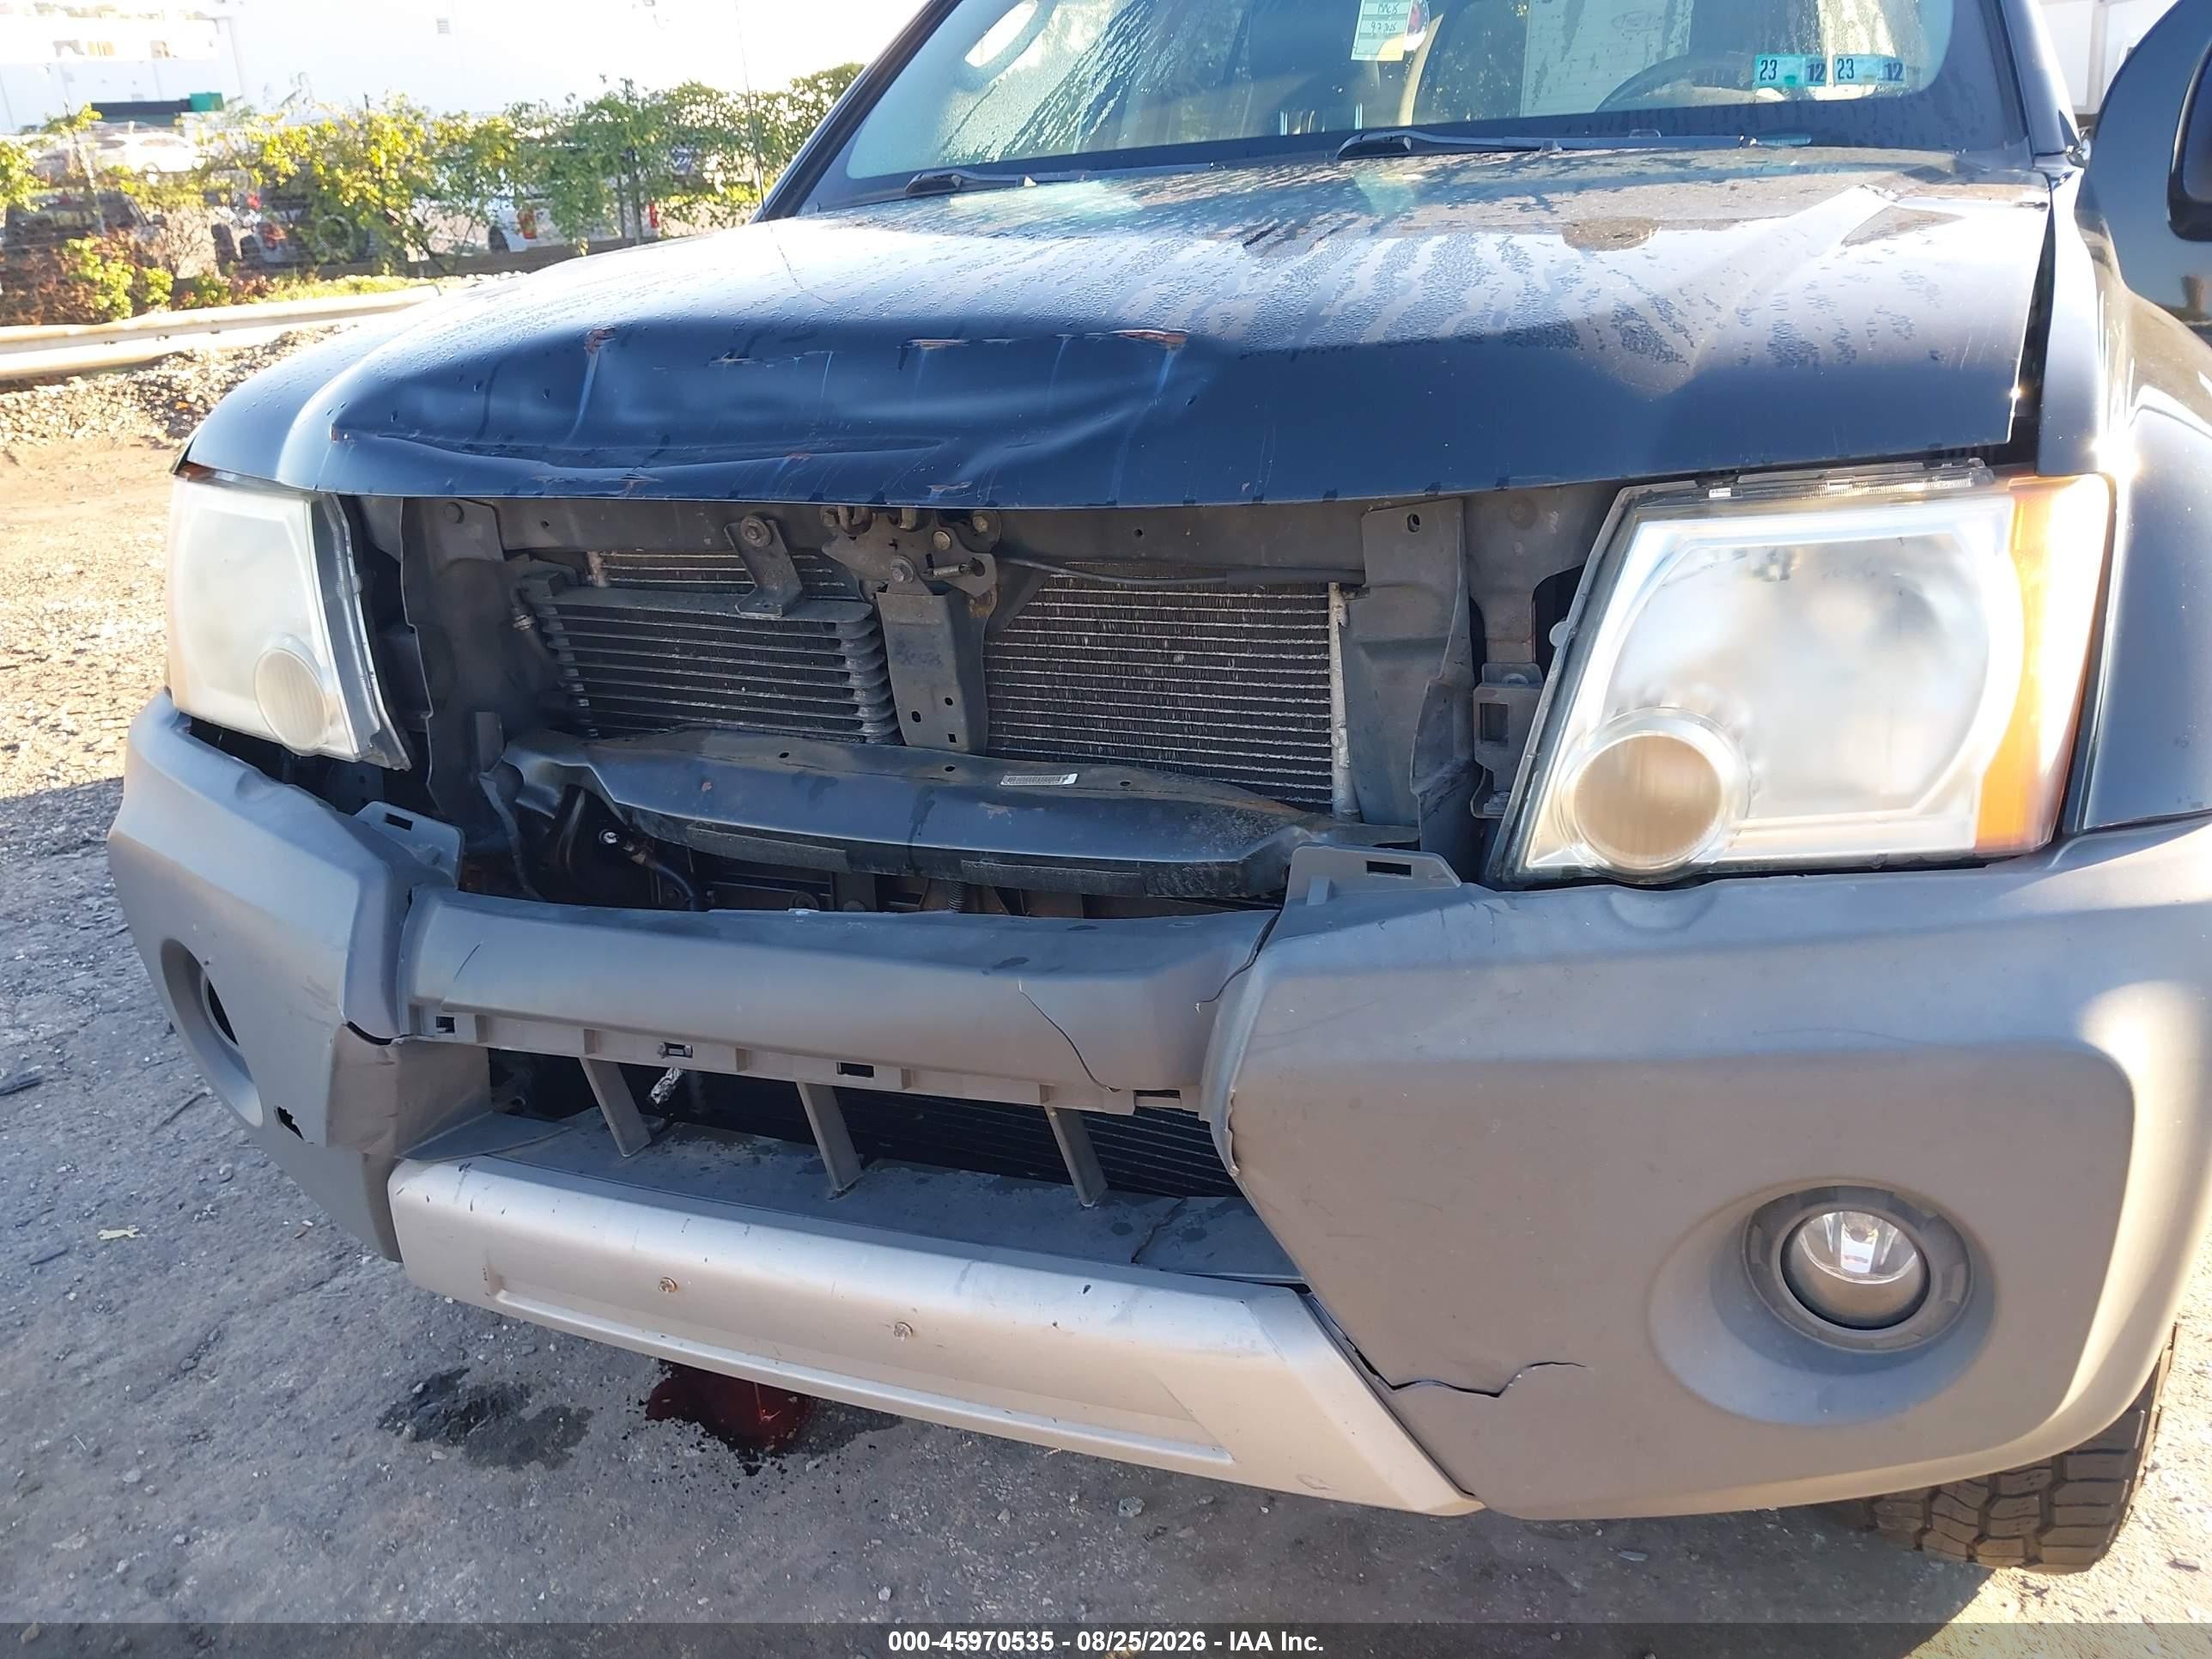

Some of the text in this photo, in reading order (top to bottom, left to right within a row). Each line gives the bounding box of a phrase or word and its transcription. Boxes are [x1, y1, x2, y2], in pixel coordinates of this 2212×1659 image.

[1759, 59, 1826, 82] 23 12
[1836, 58, 1905, 82] 23 12
